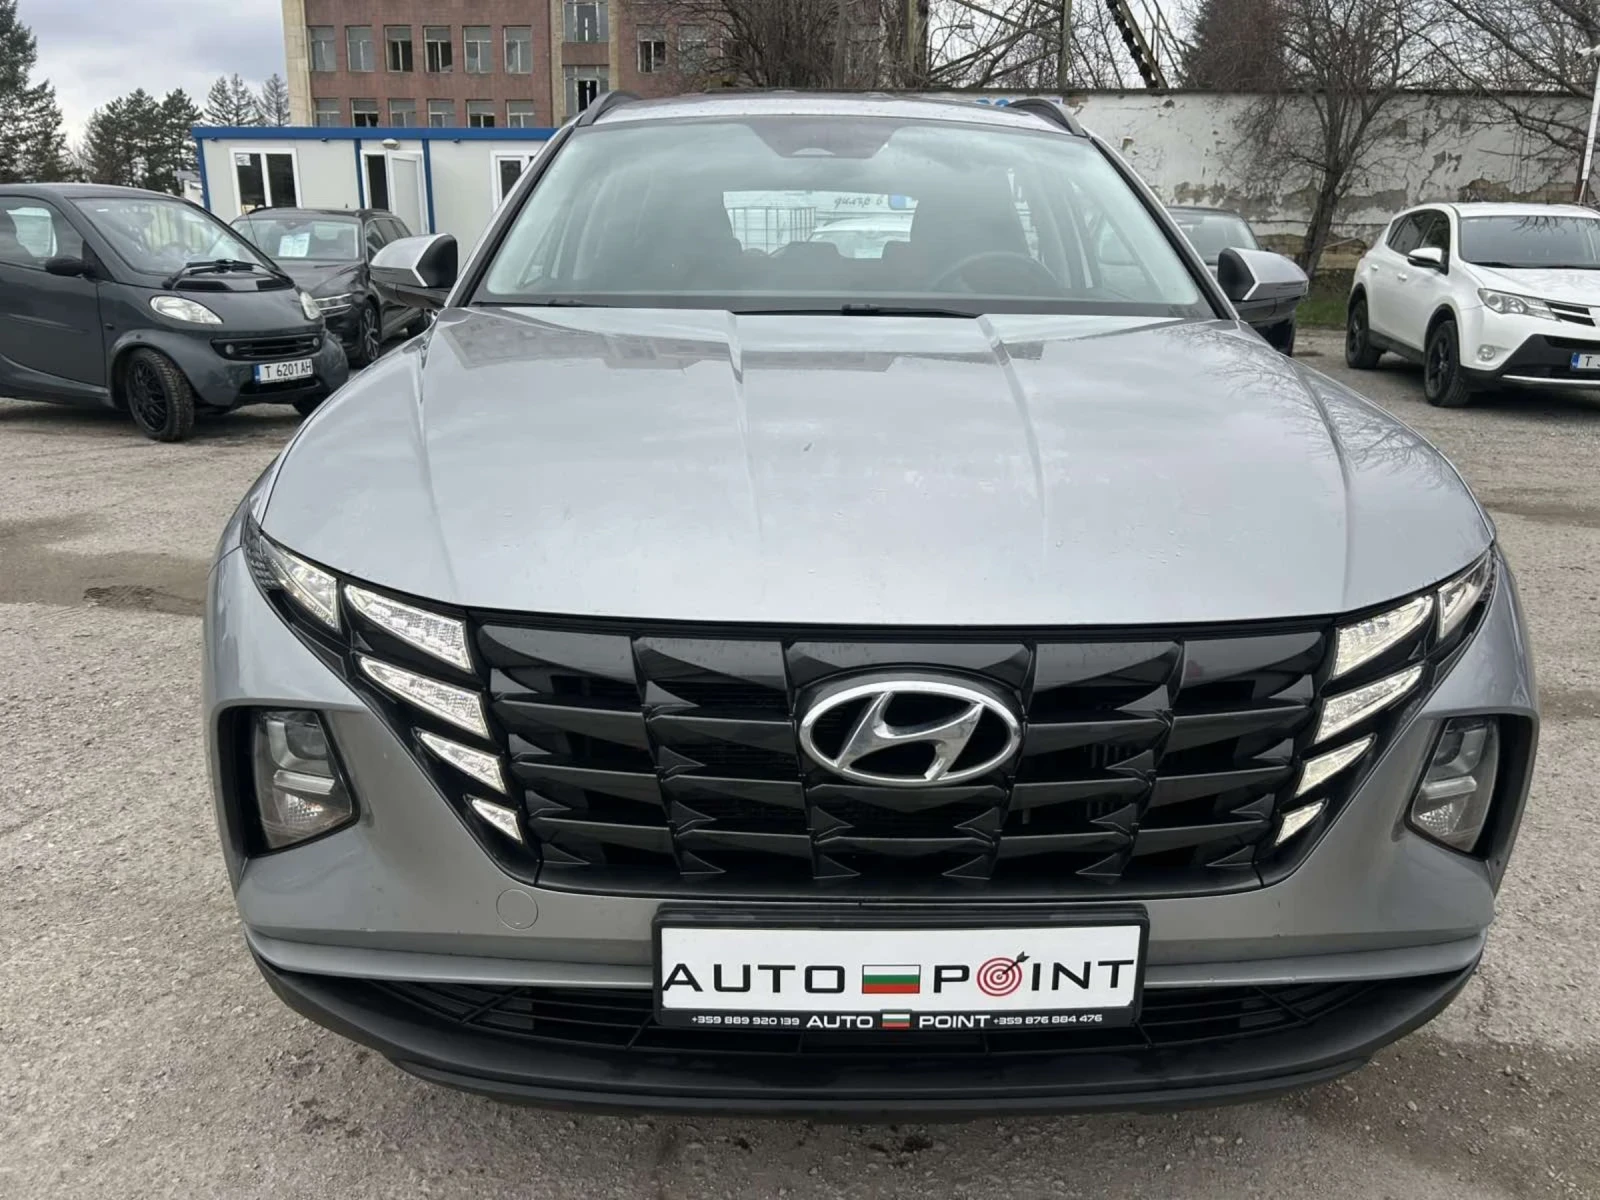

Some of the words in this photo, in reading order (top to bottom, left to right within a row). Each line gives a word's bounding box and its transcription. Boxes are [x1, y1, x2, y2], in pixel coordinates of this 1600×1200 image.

[1585, 355, 1593, 367] T
[264, 365, 272, 378] T
[276, 362, 299, 377] 6201
[300, 361, 312, 374] AH
[662, 963, 845, 994] AUTO
[691, 1015, 722, 1025] +359
[724, 1015, 750, 1025] 889
[752, 1016, 778, 1026] 920
[780, 1016, 800, 1026] 139
[806, 1015, 874, 1029] AUTO
[918, 1014, 991, 1029] POINT
[993, 1016, 1023, 1025] +359
[1025, 1015, 1049, 1024] 876
[1051, 1014, 1077, 1024] 884
[1079, 1013, 1103, 1023] 476
